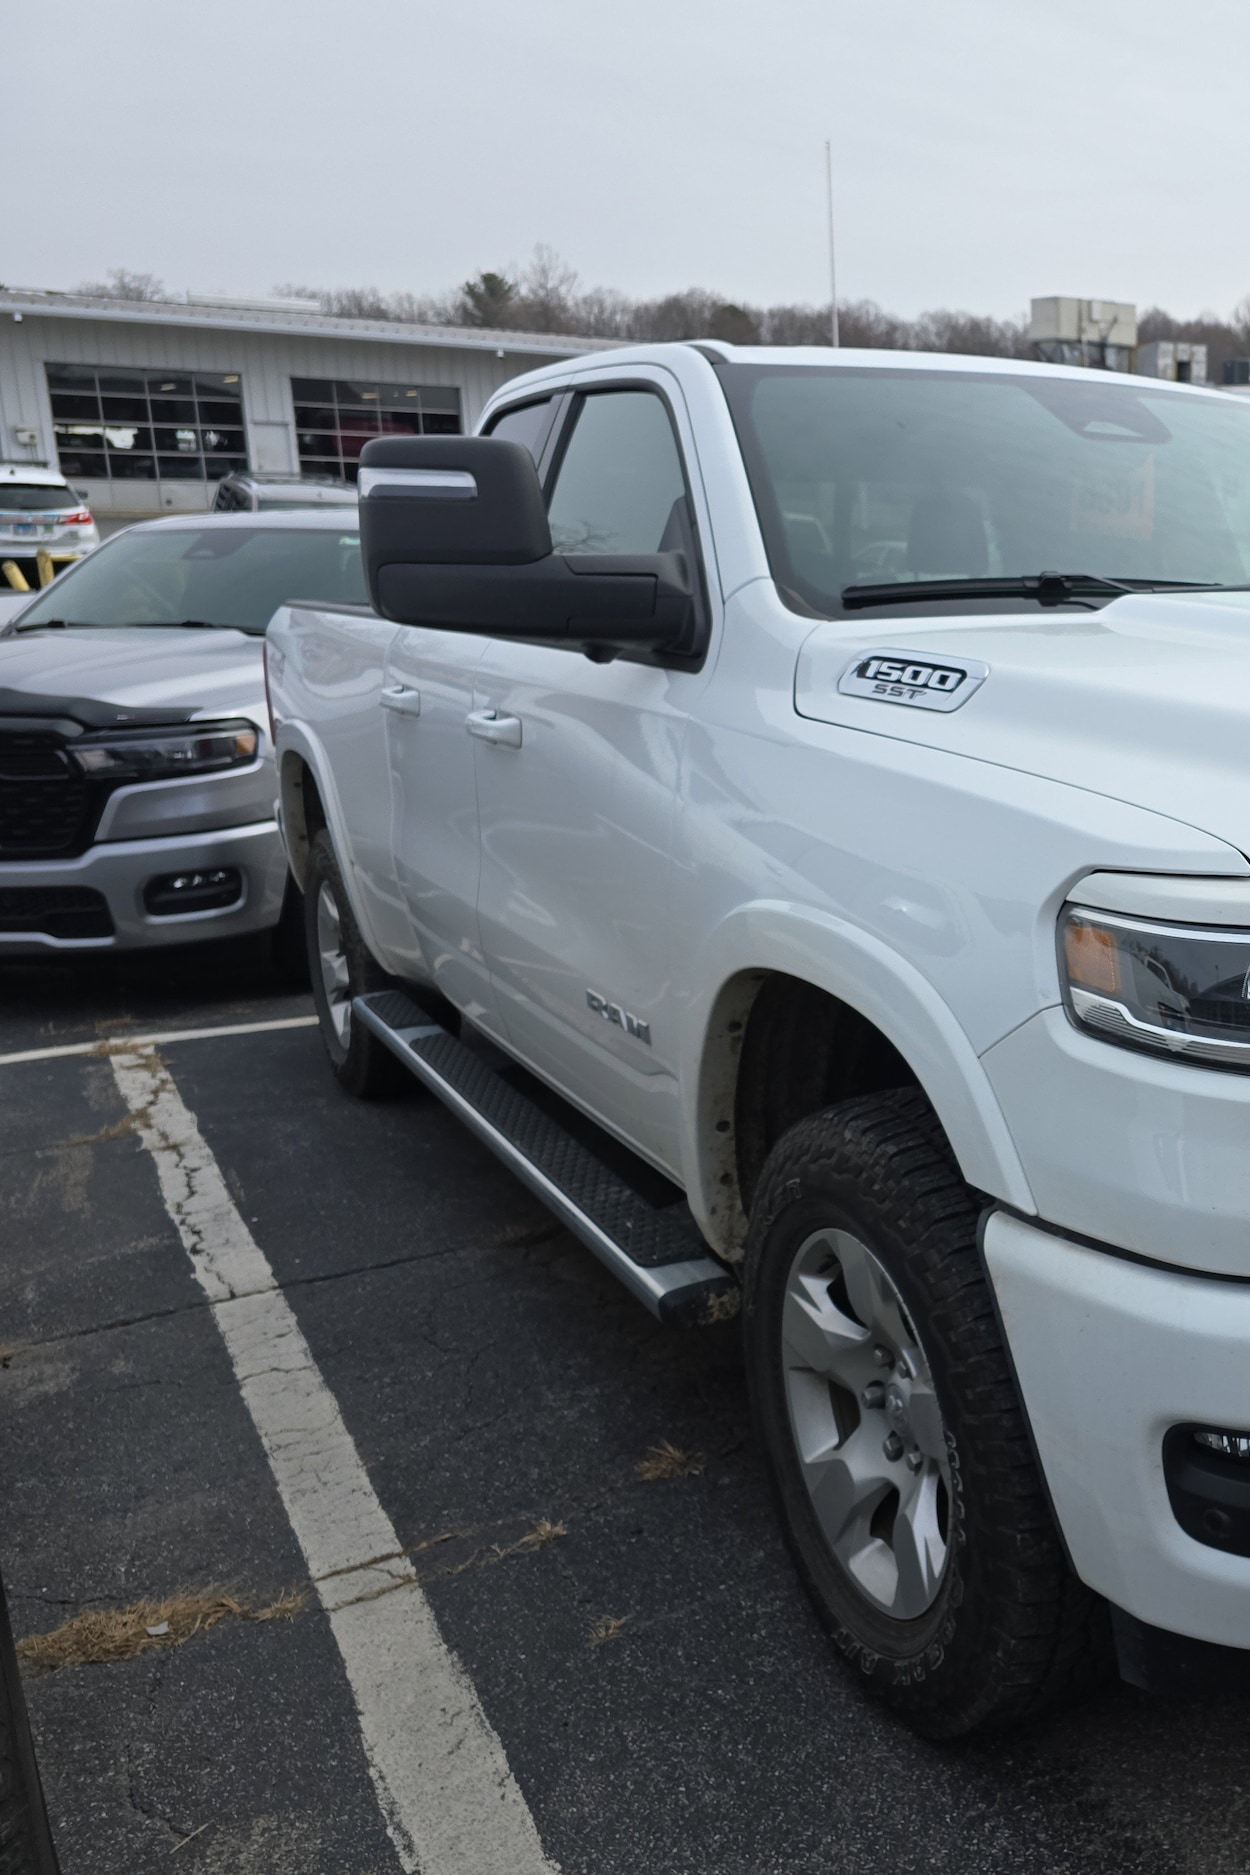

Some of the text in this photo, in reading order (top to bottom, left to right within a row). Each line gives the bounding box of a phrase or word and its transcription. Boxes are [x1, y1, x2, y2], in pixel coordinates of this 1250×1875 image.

[865, 659, 962, 691] 1500
[872, 683, 927, 700] SST
[586, 988, 652, 1046] RAM
